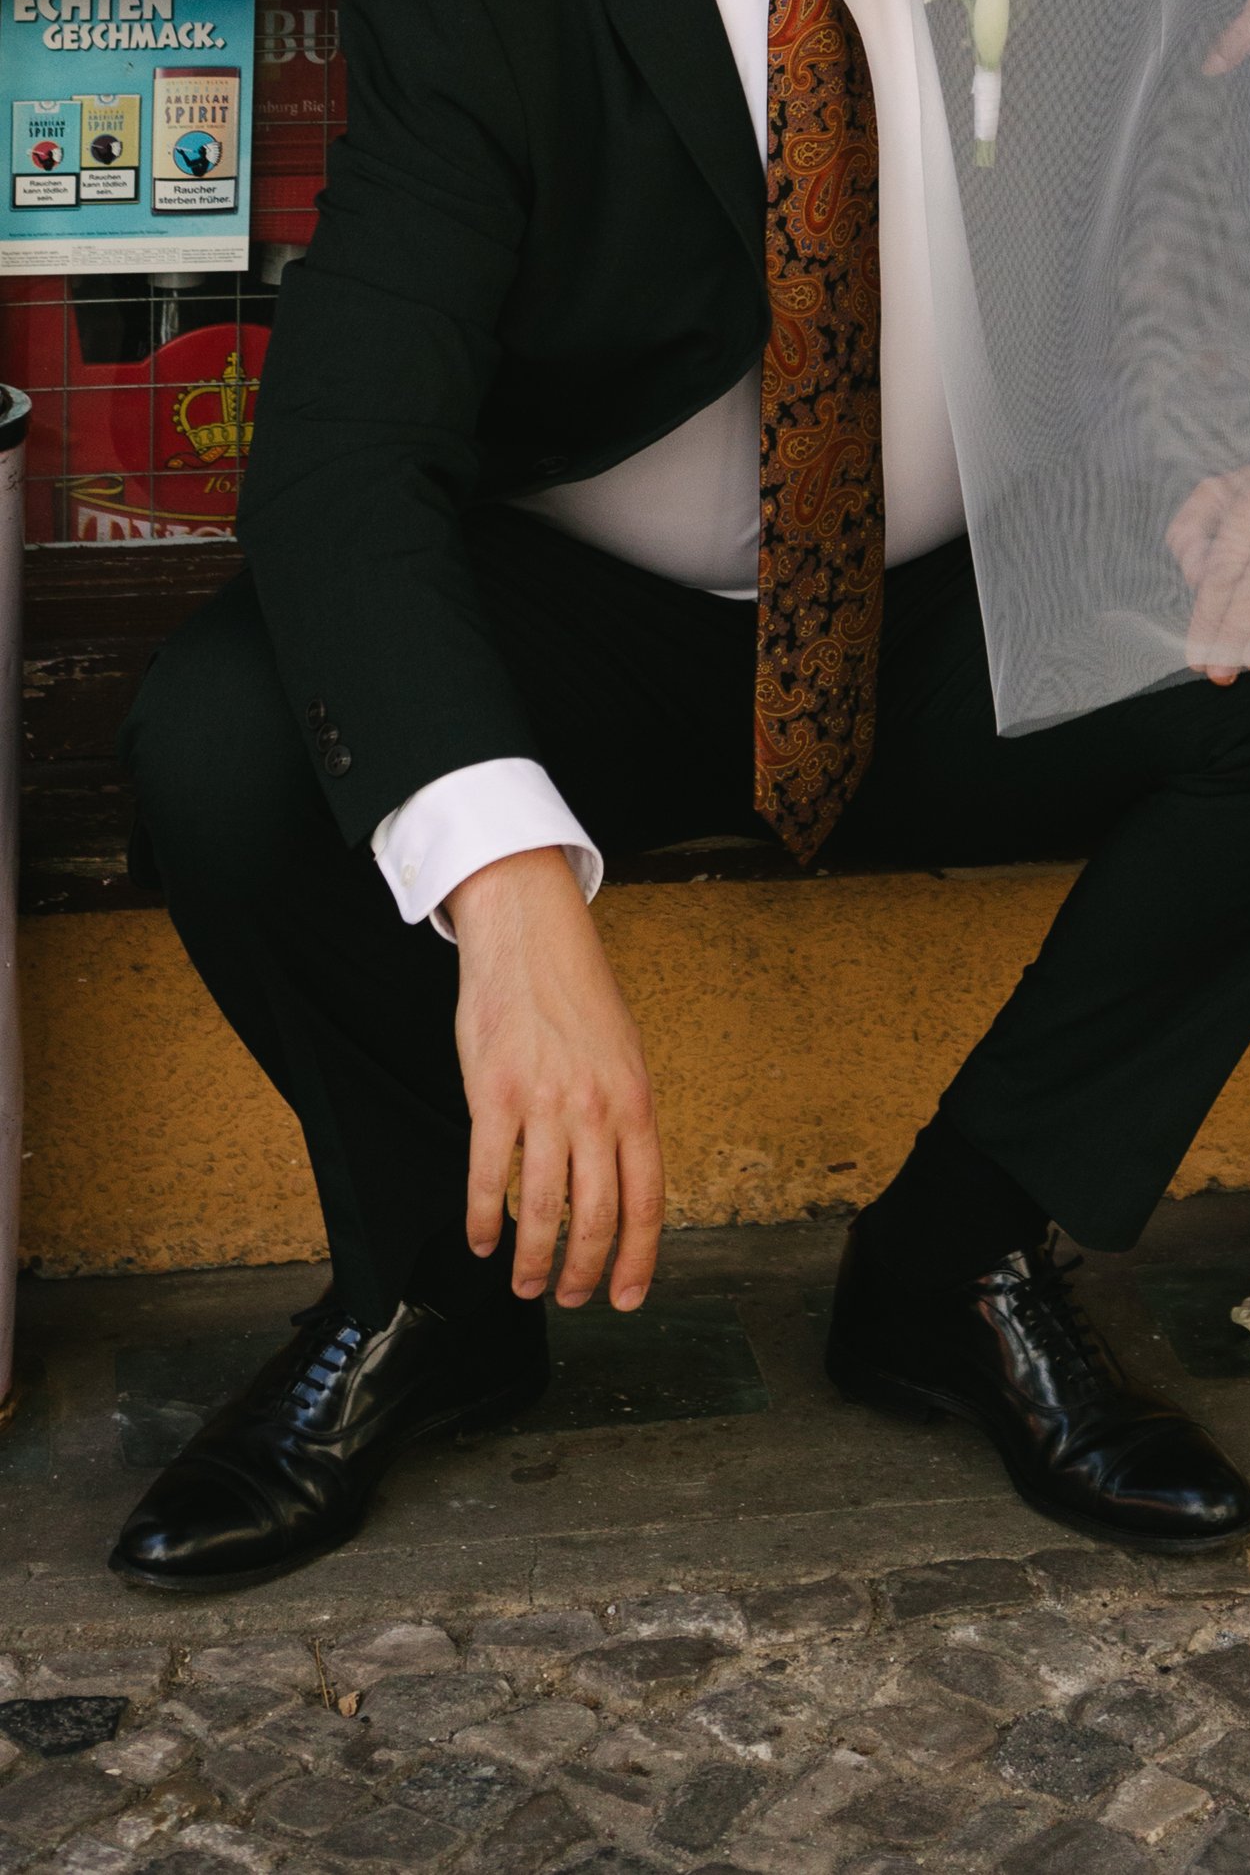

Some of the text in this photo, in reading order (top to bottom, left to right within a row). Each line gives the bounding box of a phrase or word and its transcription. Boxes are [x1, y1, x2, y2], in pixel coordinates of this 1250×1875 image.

[43, 22, 227, 51] GESCHMACK.
[165, 94, 229, 105] AMERICAN
[165, 106, 229, 124] SPIRIT
[28, 127, 66, 138] SPIRIT
[173, 185, 217, 195] Raucher
[158, 194, 232, 205] sterben früher.
